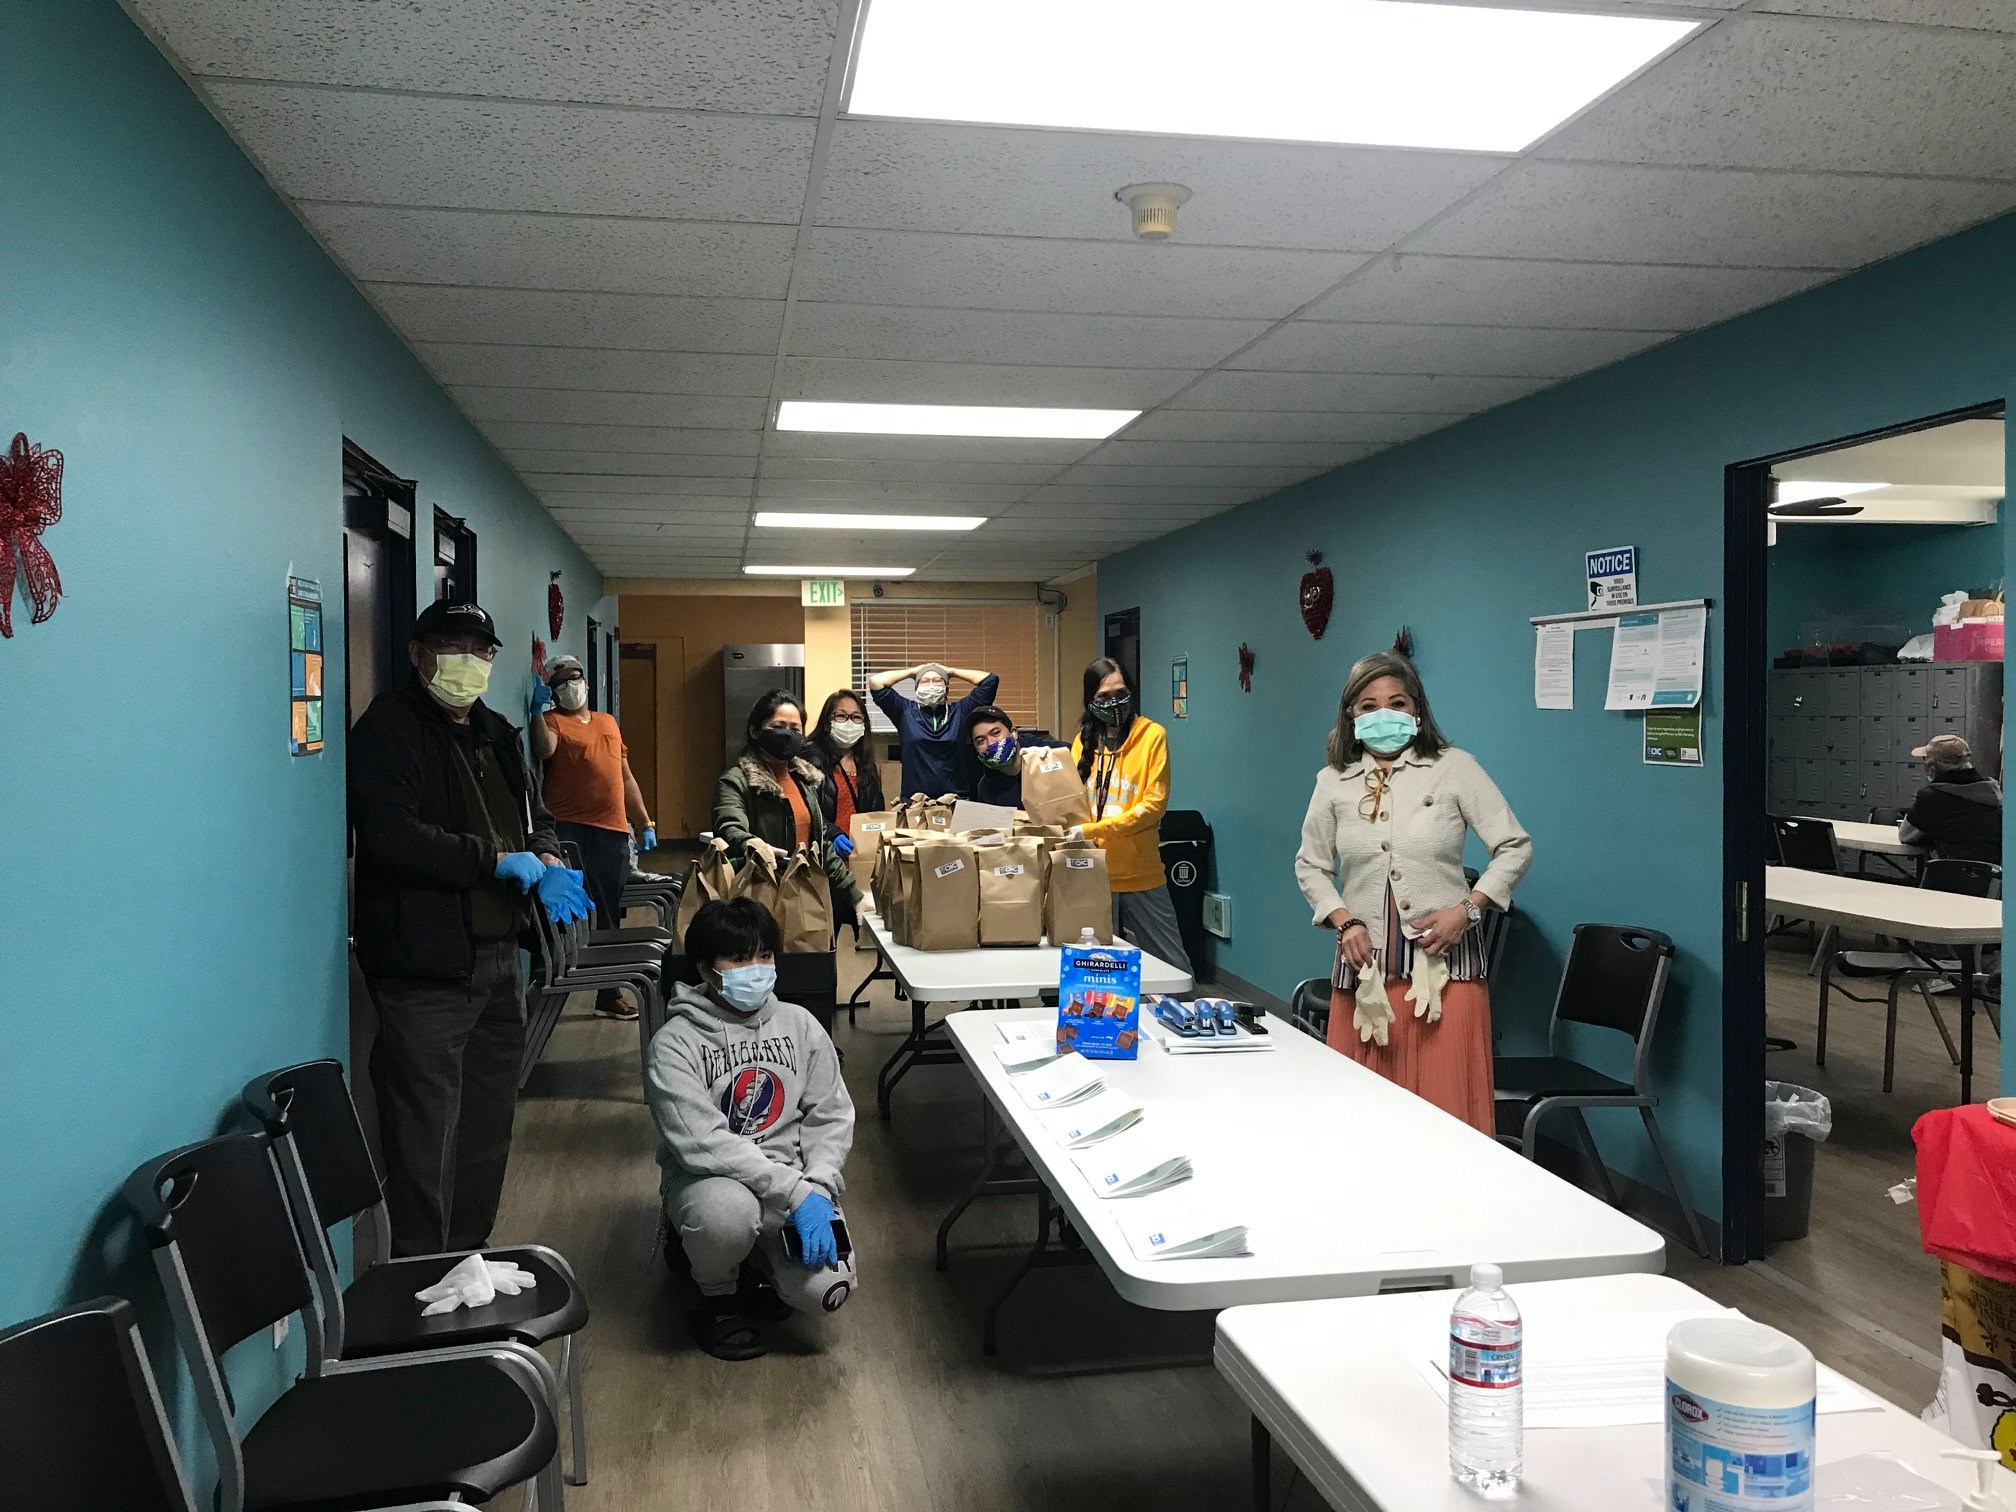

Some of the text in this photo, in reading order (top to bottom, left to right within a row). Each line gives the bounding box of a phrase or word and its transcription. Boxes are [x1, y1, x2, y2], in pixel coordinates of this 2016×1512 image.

[1590, 553, 1631, 575] NOTICE
[809, 581, 838, 603] EXIT
[1075, 960, 1126, 969] GHIRARDELLI
[1083, 973, 1117, 984] minis
[1491, 1351, 1515, 1361] CRYSTAL
[1674, 1397, 1703, 1420] CLOROX
